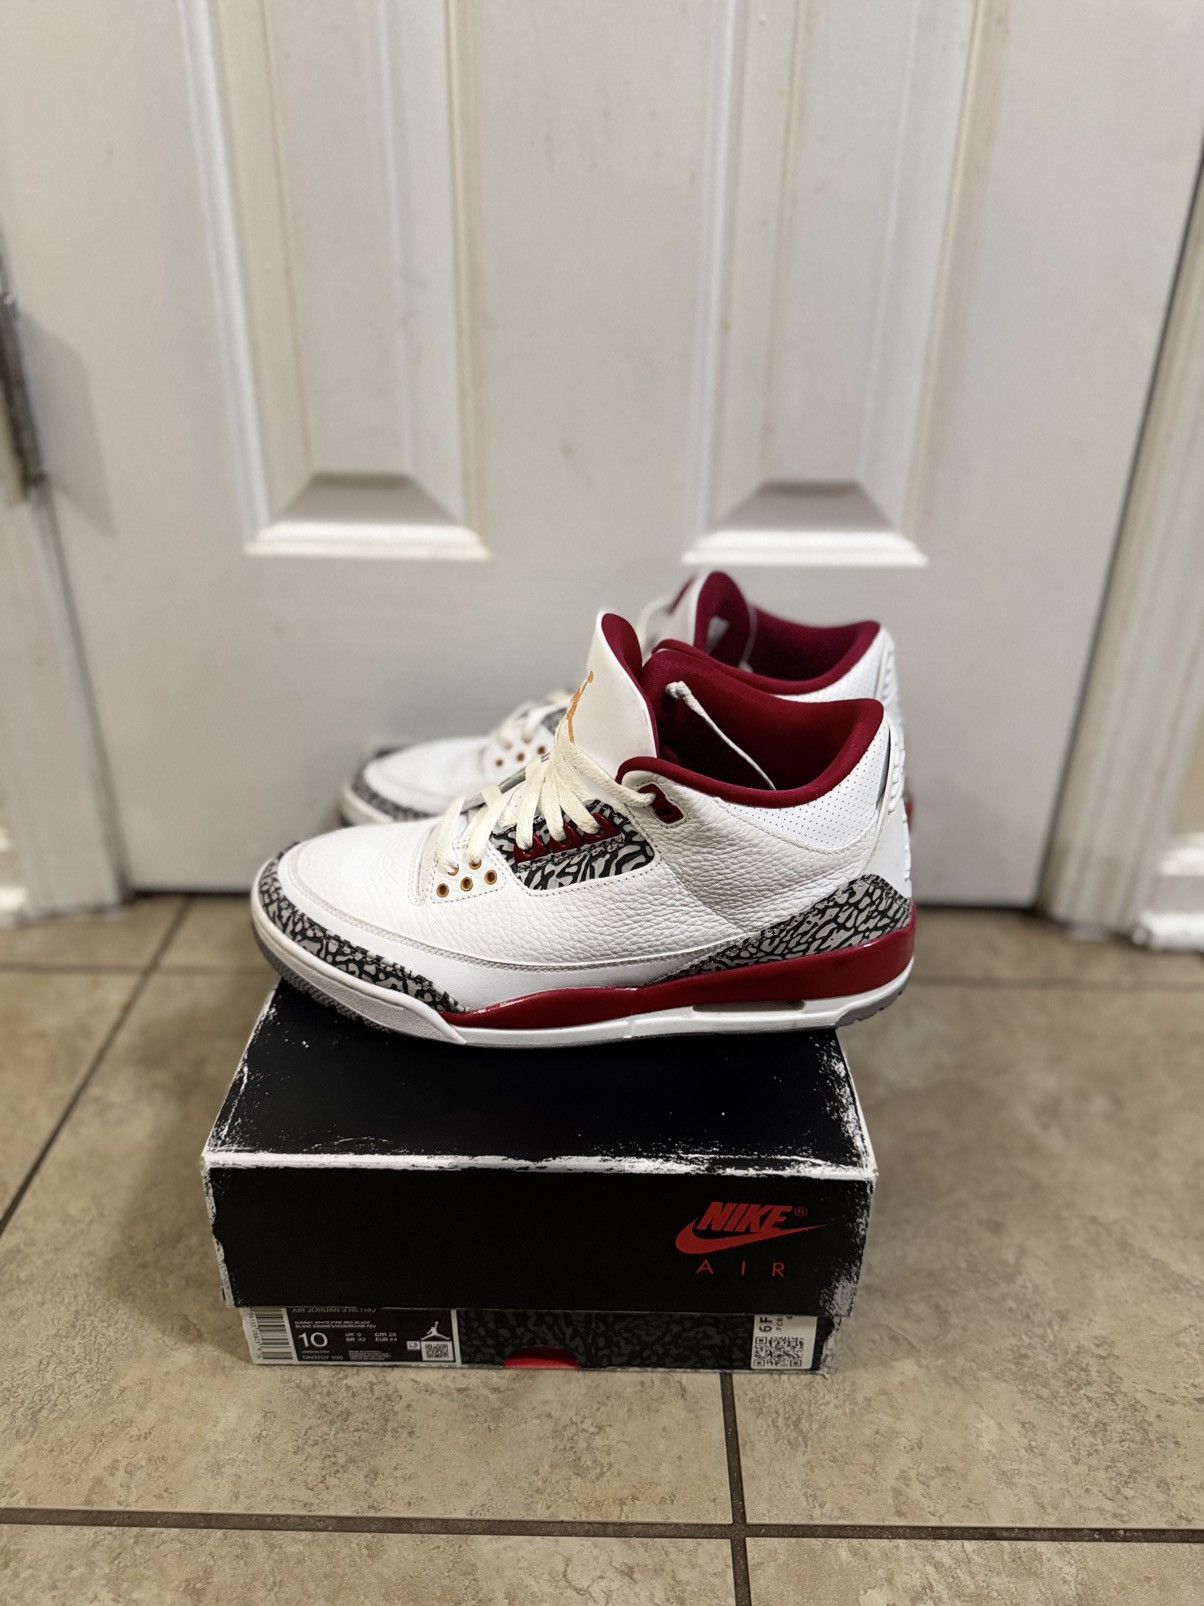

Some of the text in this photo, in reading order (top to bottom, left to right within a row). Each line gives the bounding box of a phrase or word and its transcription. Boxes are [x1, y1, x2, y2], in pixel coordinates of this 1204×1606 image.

[696, 1202, 793, 1232] NIKE
[696, 1259, 786, 1278] AIR
[298, 1331, 329, 1348] 10
